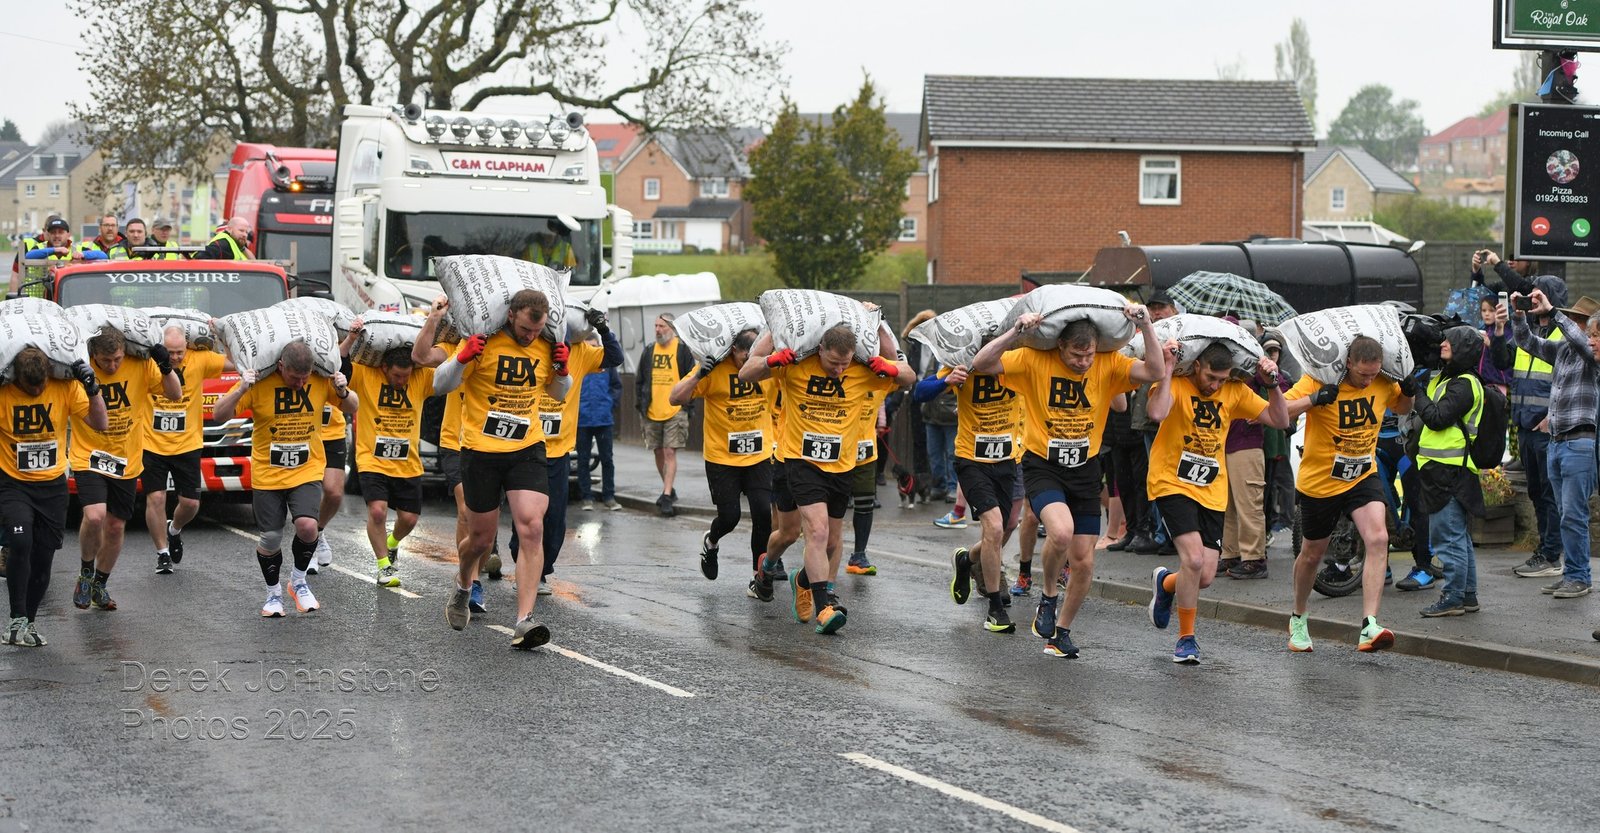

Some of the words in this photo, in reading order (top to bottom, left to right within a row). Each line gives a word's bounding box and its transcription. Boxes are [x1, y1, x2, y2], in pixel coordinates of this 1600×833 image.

[1531, 10, 1563, 28] Royal
[1566, 11, 1588, 26] Oak
[1539, 129, 1573, 139] Incoming
[1574, 130, 1589, 138] Call
[452, 159, 481, 169] C&M
[485, 160, 545, 172] CLAPHAM
[1552, 186, 1573, 195] Pizza
[1560, 195, 1588, 203] 939933
[106, 272, 241, 283] YORKSHIRE
[475, 257, 495, 294] Gawthorpe
[449, 261, 477, 319] Championships
[502, 290, 510, 305] The
[472, 282, 490, 321] Carrying
[775, 291, 795, 334] Championships
[794, 302, 805, 337] Carrying
[161, 417, 177, 431] 60
[495, 421, 518, 438] 57
[543, 420, 552, 436] 0
[383, 444, 401, 457] 38
[737, 438, 755, 453] 35
[811, 441, 831, 459] 33
[984, 442, 1004, 458] 44
[28, 451, 49, 468] 56
[280, 451, 299, 466] 45
[1058, 448, 1080, 465] 53
[97, 460, 117, 474] 59
[1187, 464, 1210, 483] 42
[1342, 464, 1363, 479] 54
